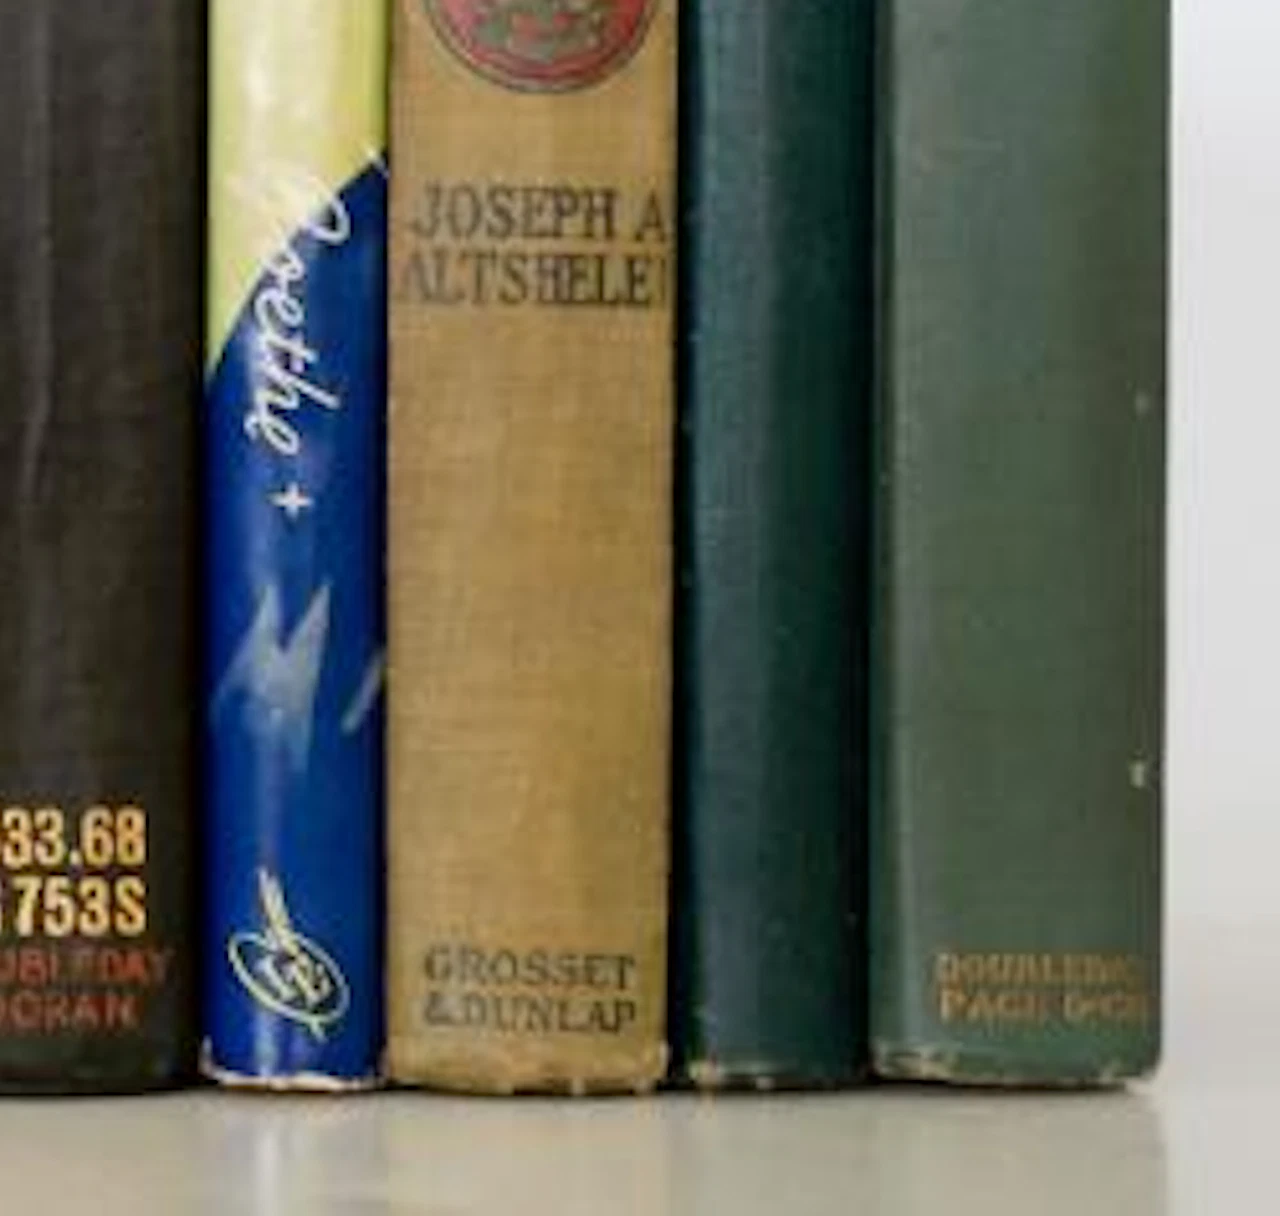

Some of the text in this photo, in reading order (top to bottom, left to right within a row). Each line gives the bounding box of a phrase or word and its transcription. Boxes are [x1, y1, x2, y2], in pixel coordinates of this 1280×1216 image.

[413, 186, 667, 242] JOSEPH A
[423, 945, 636, 989] GROSSET
